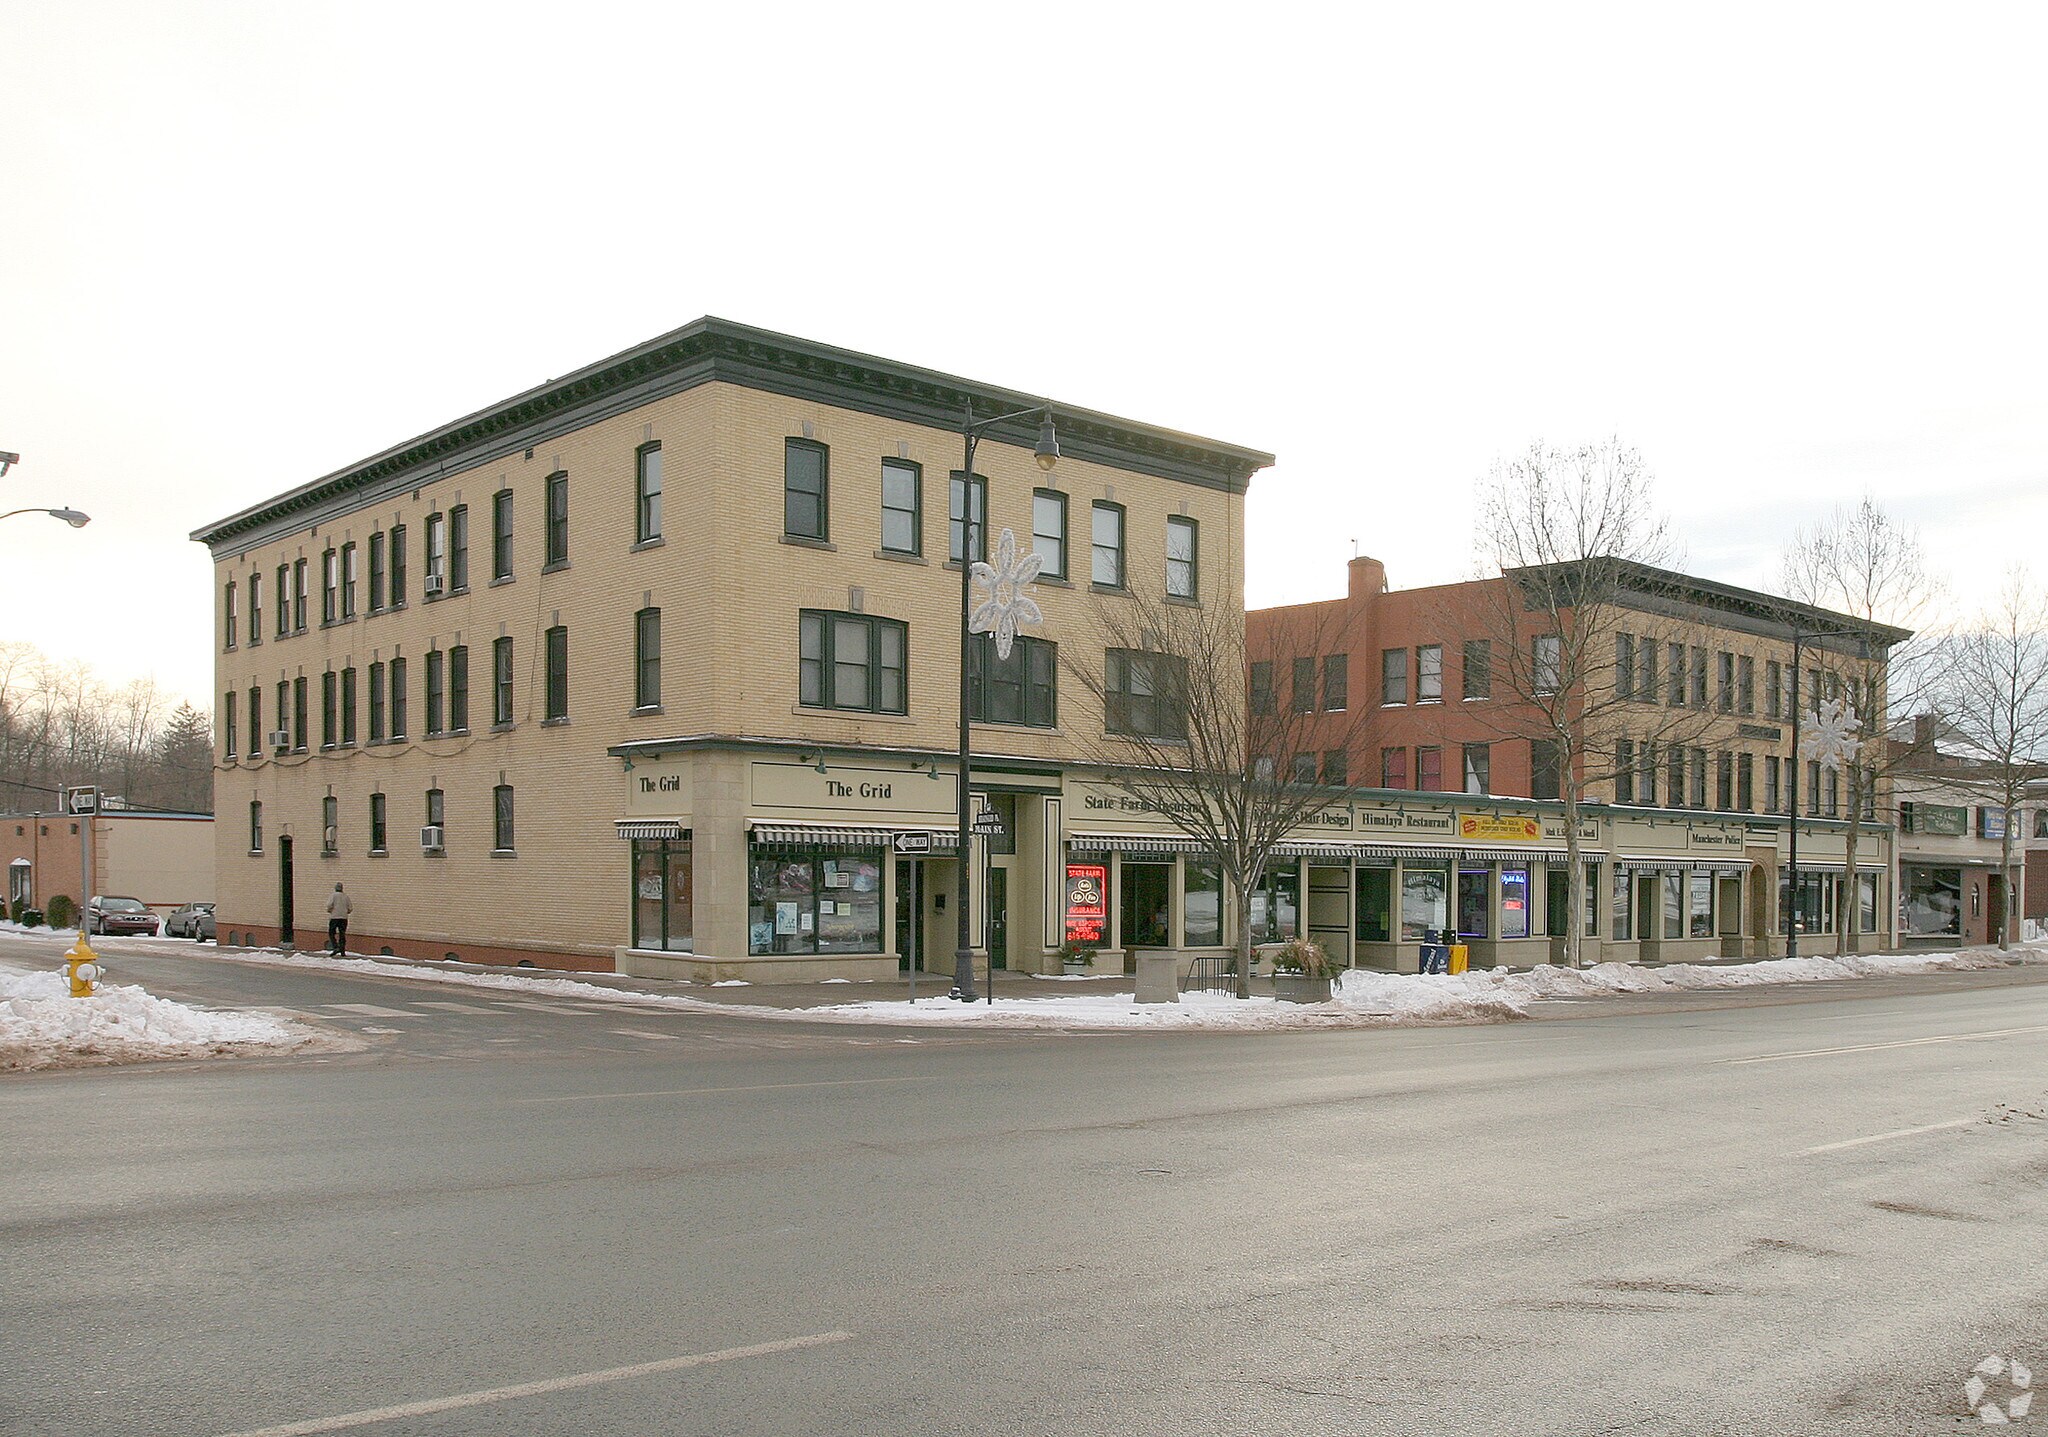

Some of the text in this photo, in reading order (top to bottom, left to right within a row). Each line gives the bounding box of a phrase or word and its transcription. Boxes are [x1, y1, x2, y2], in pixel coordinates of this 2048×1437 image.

[639, 775, 680, 792] The Grid
[825, 780, 892, 799] The Grid
[1084, 795, 1114, 810] State
[1322, 812, 1350, 828] Design
[1362, 813, 1403, 828] Himalaya
[1406, 815, 1449, 829] Restaurant
[974, 824, 1005, 834] MAIN ST.
[902, 838, 926, 847] ONE WAY
